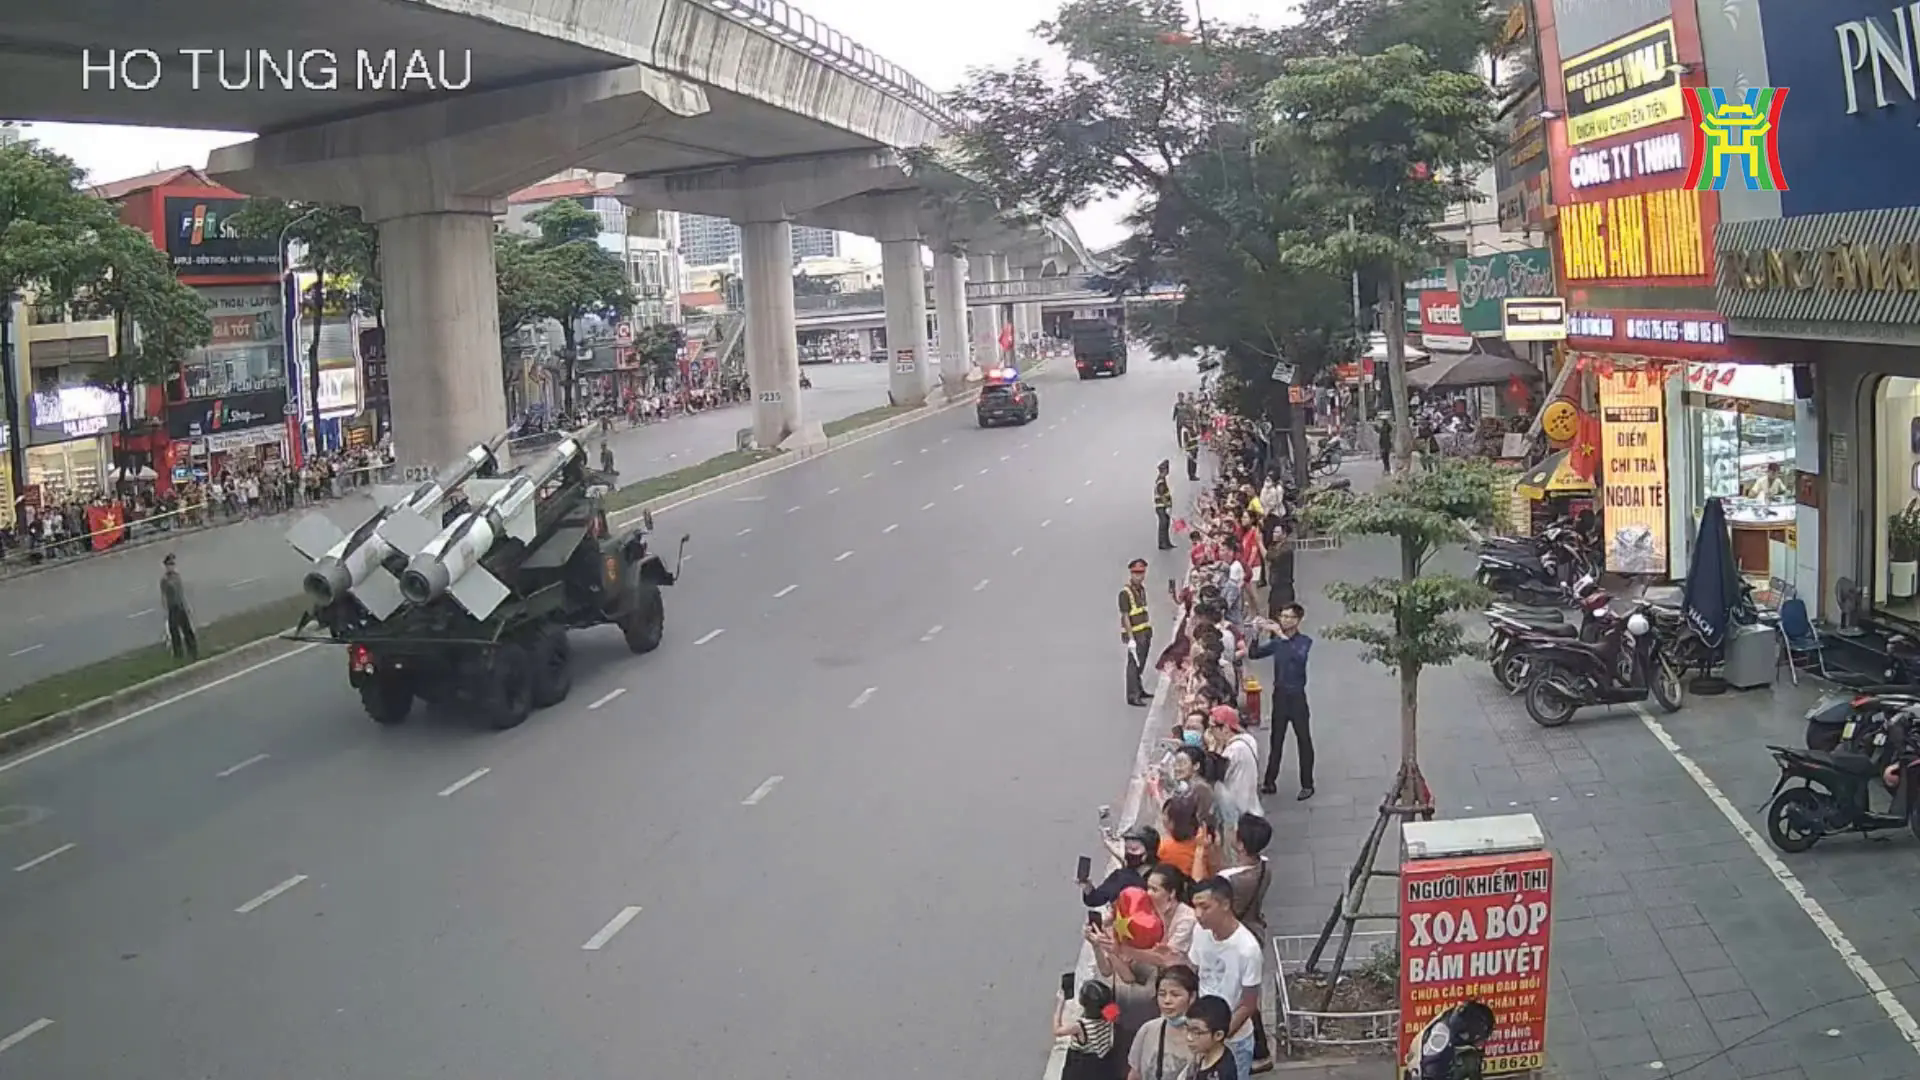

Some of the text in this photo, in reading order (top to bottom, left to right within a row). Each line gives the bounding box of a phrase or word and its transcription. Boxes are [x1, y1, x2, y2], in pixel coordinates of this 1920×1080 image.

[1567, 57, 1622, 92] WESTERN
[1584, 75, 1624, 104] UNION
[1570, 147, 1611, 188] CÔNG
[1611, 144, 1631, 179] TY
[1608, 194, 1647, 277] ANH
[1611, 458, 1630, 473] CHI
[1408, 867, 1548, 902] NGƯỜI KHIẾM THỊ
[1409, 894, 1548, 947] XOA BÓP
[1409, 942, 1545, 984] BẤM HUYỆT
